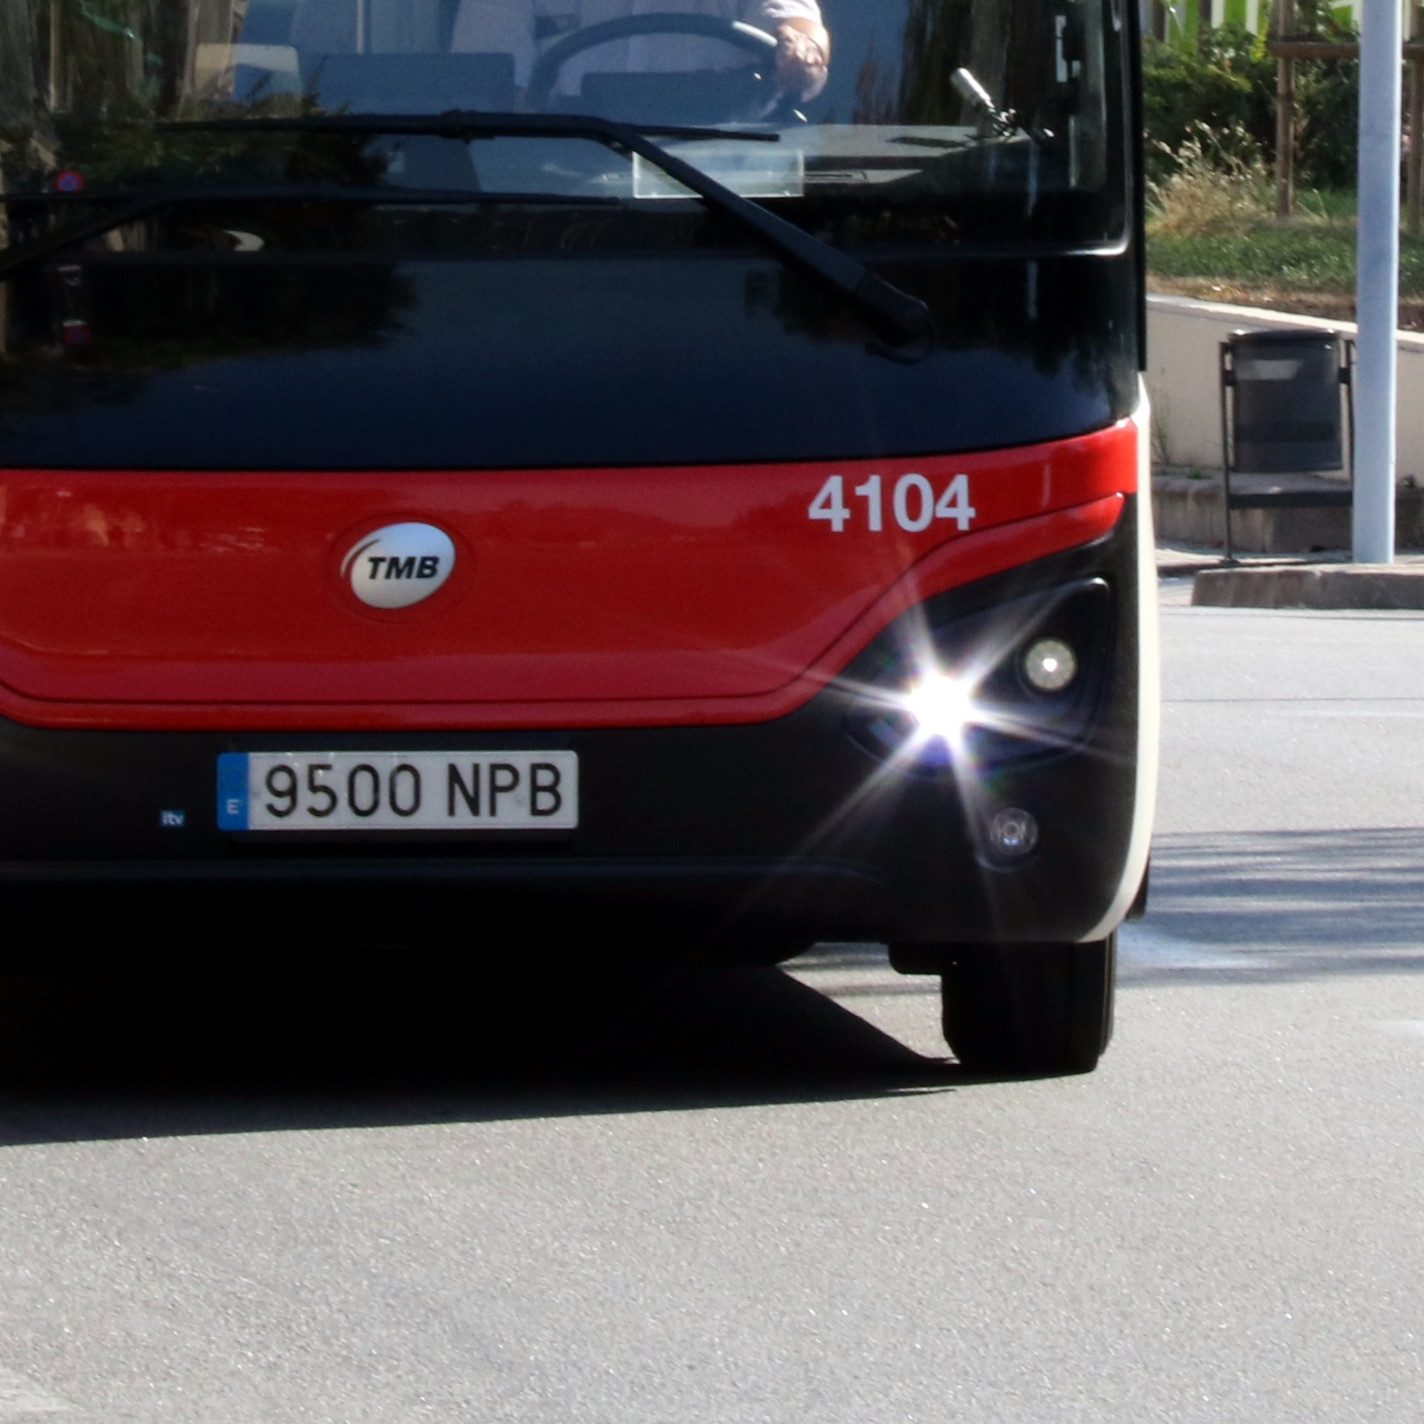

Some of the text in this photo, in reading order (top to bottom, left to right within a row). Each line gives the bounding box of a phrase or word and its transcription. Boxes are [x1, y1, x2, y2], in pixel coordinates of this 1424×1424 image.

[808, 473, 976, 532] 4104
[368, 557, 440, 580] TMB
[227, 798, 240, 815] E
[265, 763, 562, 818] 9500 NPB
